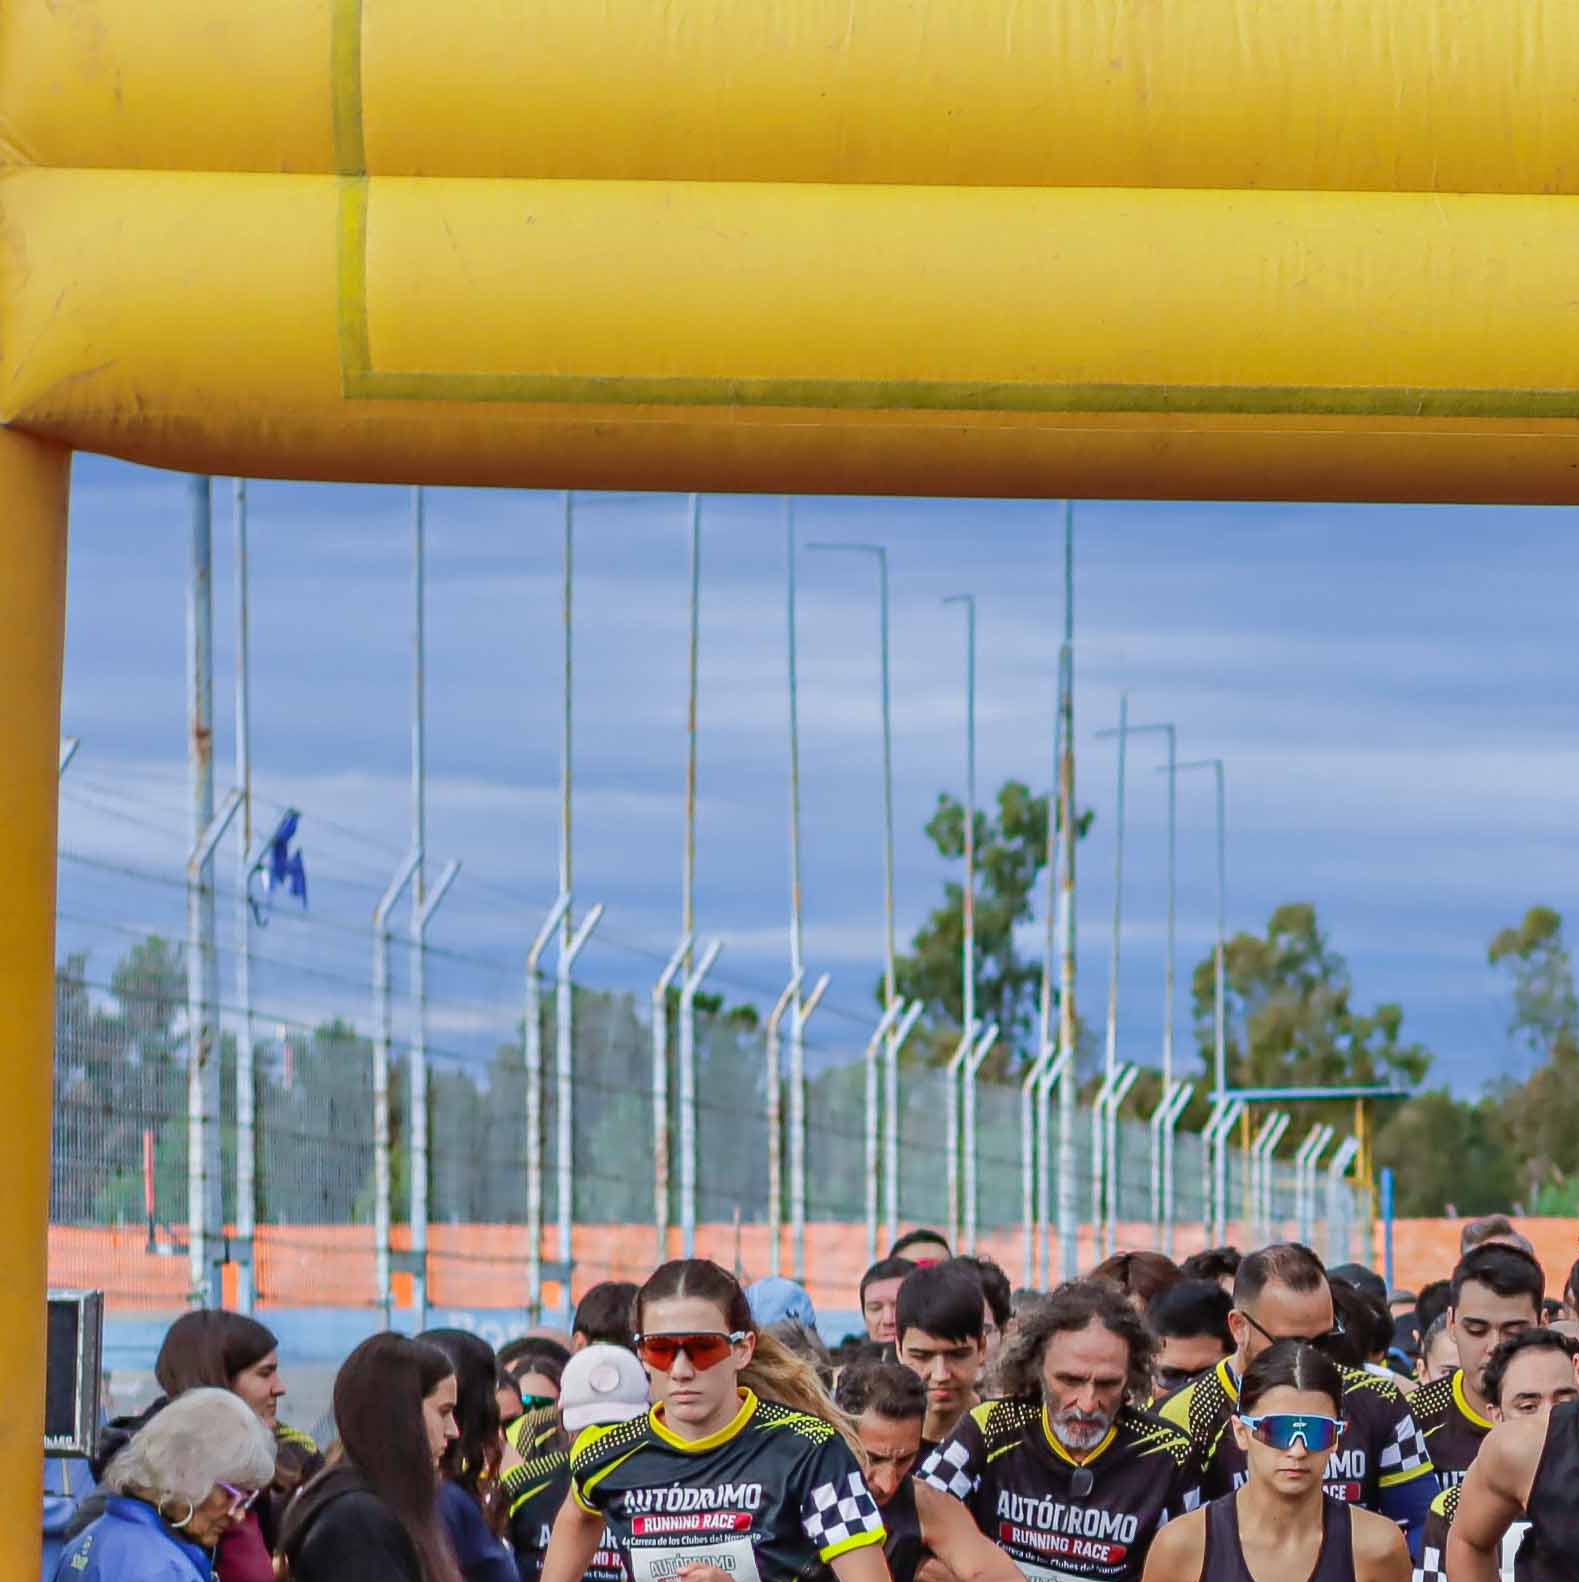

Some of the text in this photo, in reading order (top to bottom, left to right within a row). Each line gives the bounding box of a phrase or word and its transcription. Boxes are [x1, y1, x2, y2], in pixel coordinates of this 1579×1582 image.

[624, 1482, 762, 1514] AUTÓDROMO
[644, 1513, 737, 1533] RUNNING RACE
[997, 1490, 1139, 1544] AUTÓDROMO
[631, 1536, 657, 1547] Carrera
[657, 1536, 667, 1546] de
[669, 1535, 681, 1546] los
[682, 1533, 708, 1545] Clubes
[1012, 1526, 1113, 1562] RUNNING RACE
